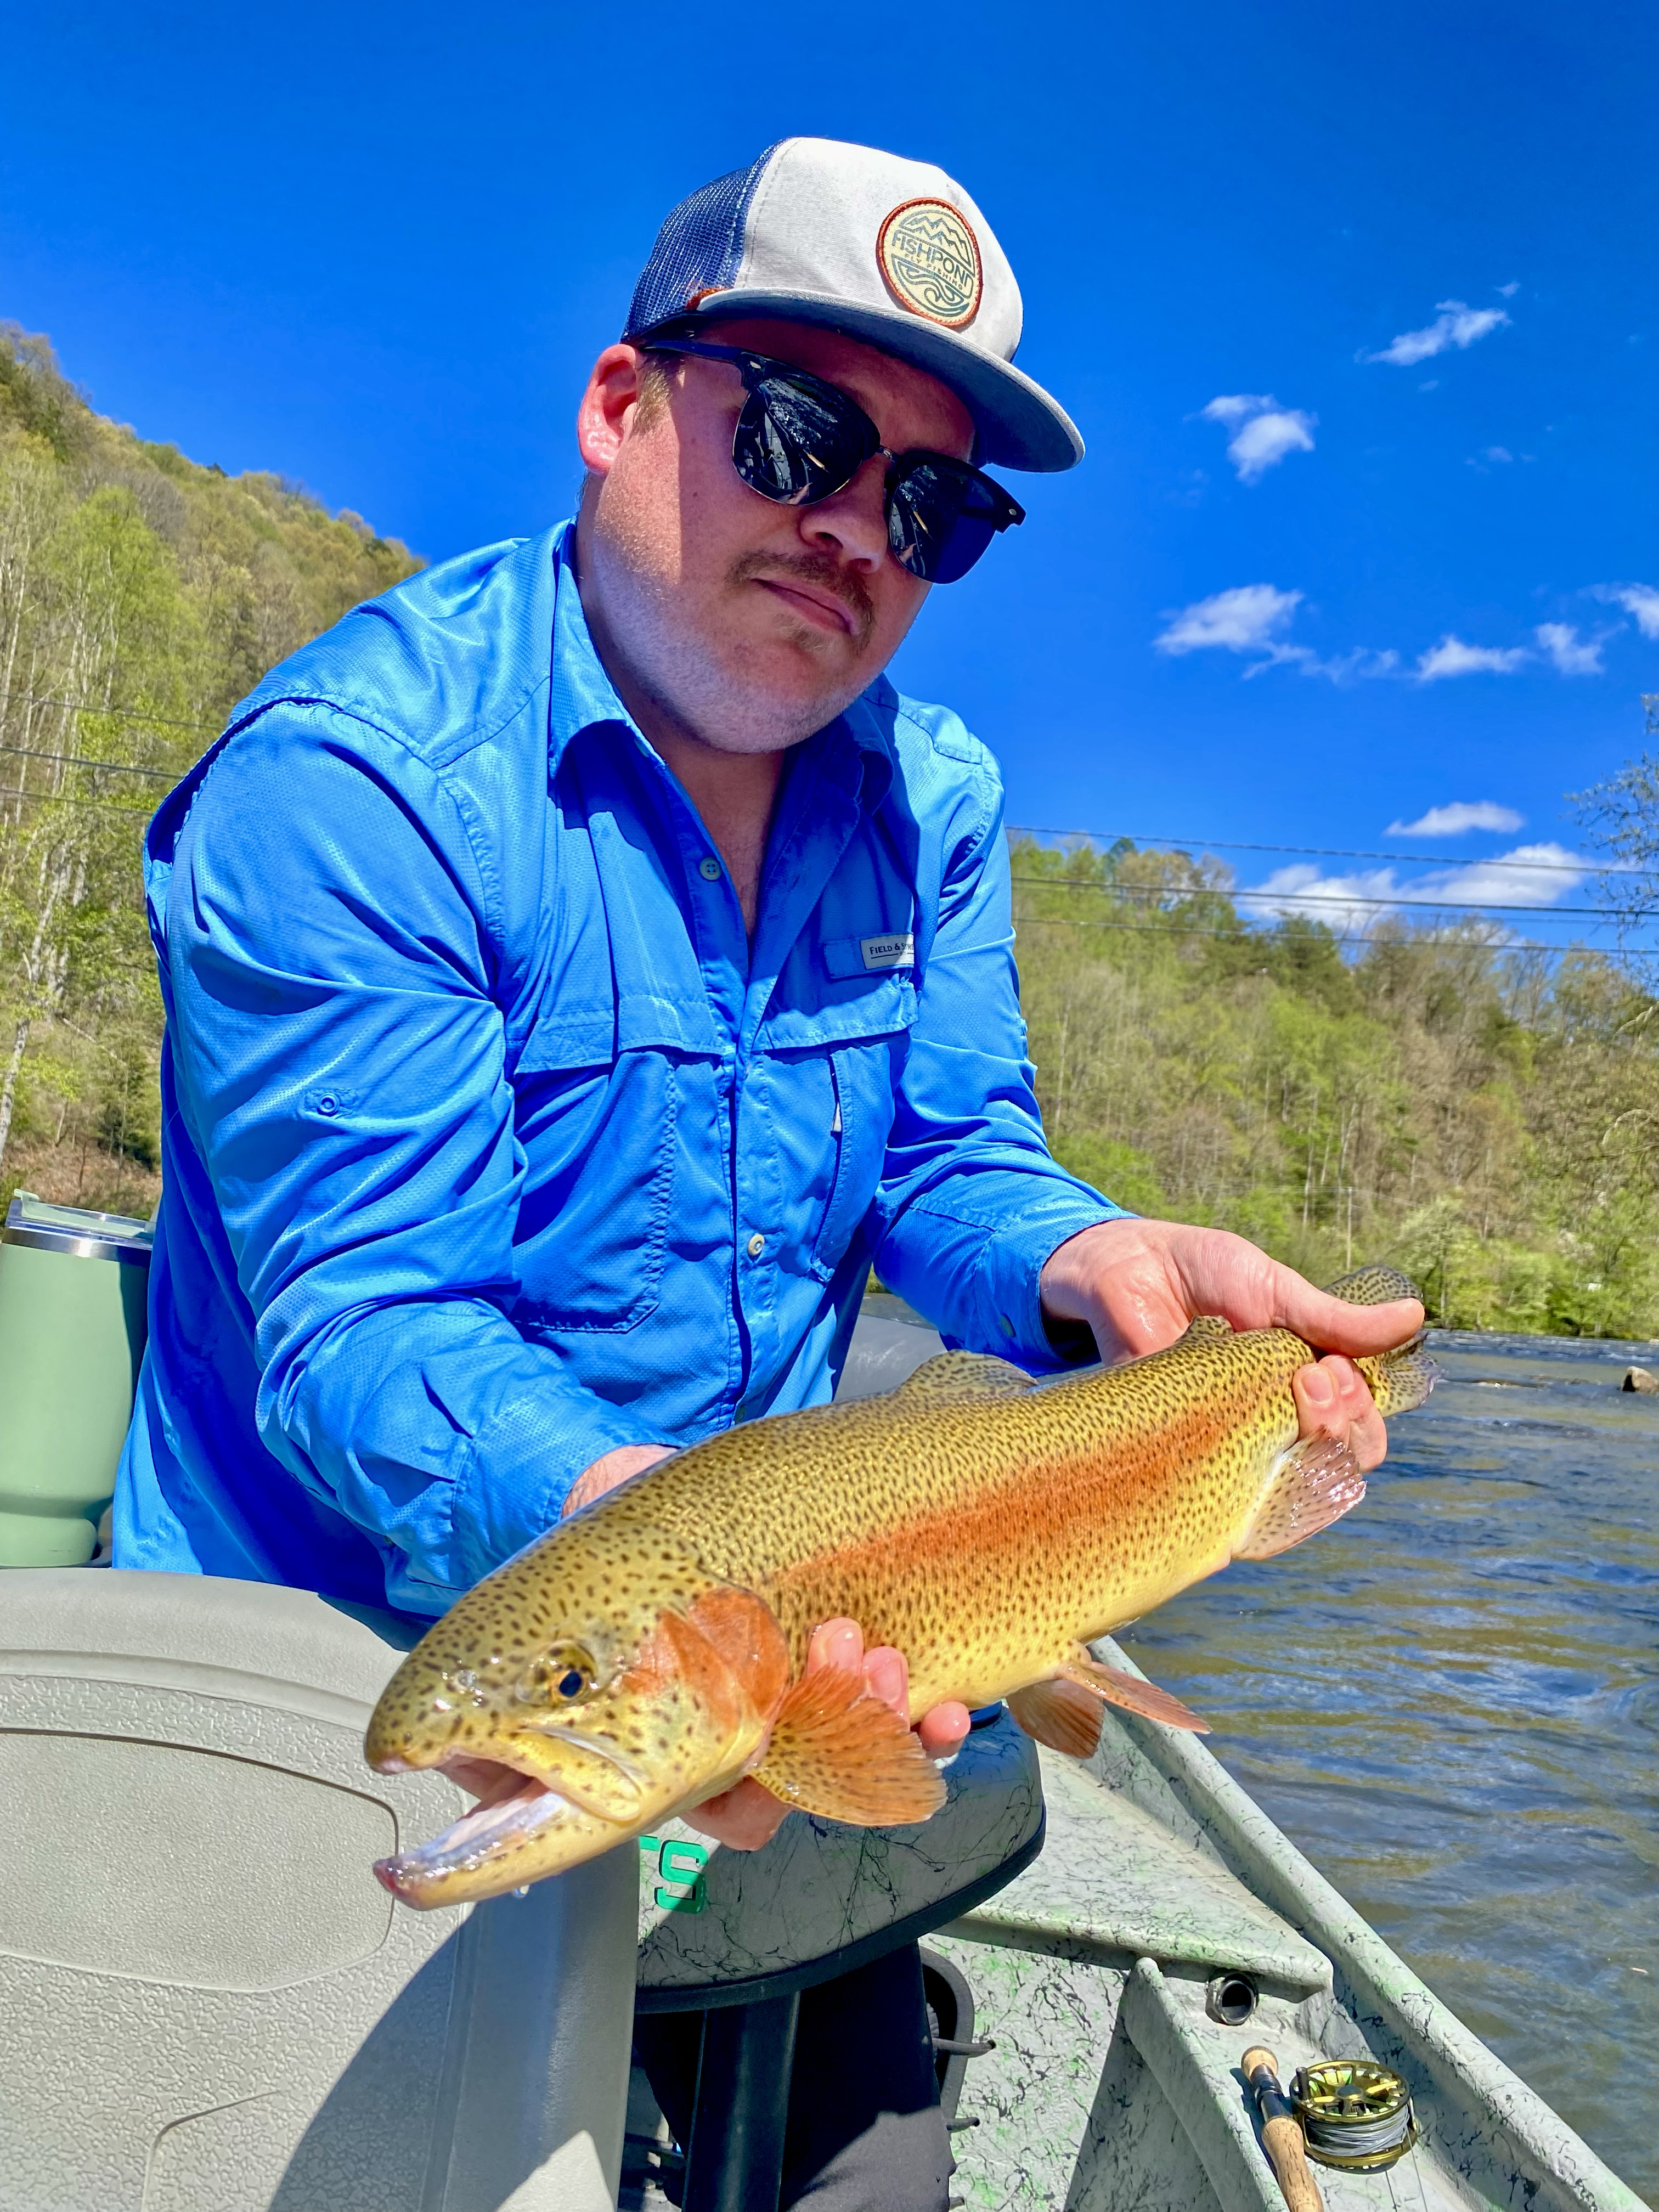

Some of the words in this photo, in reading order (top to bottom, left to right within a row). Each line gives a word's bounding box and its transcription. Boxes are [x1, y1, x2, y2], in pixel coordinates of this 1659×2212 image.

[891, 230, 974, 298] FISHPOND
[905, 253, 921, 264] FLY
[927, 263, 963, 290] FISHING
[870, 946, 893, 955] FIELD
